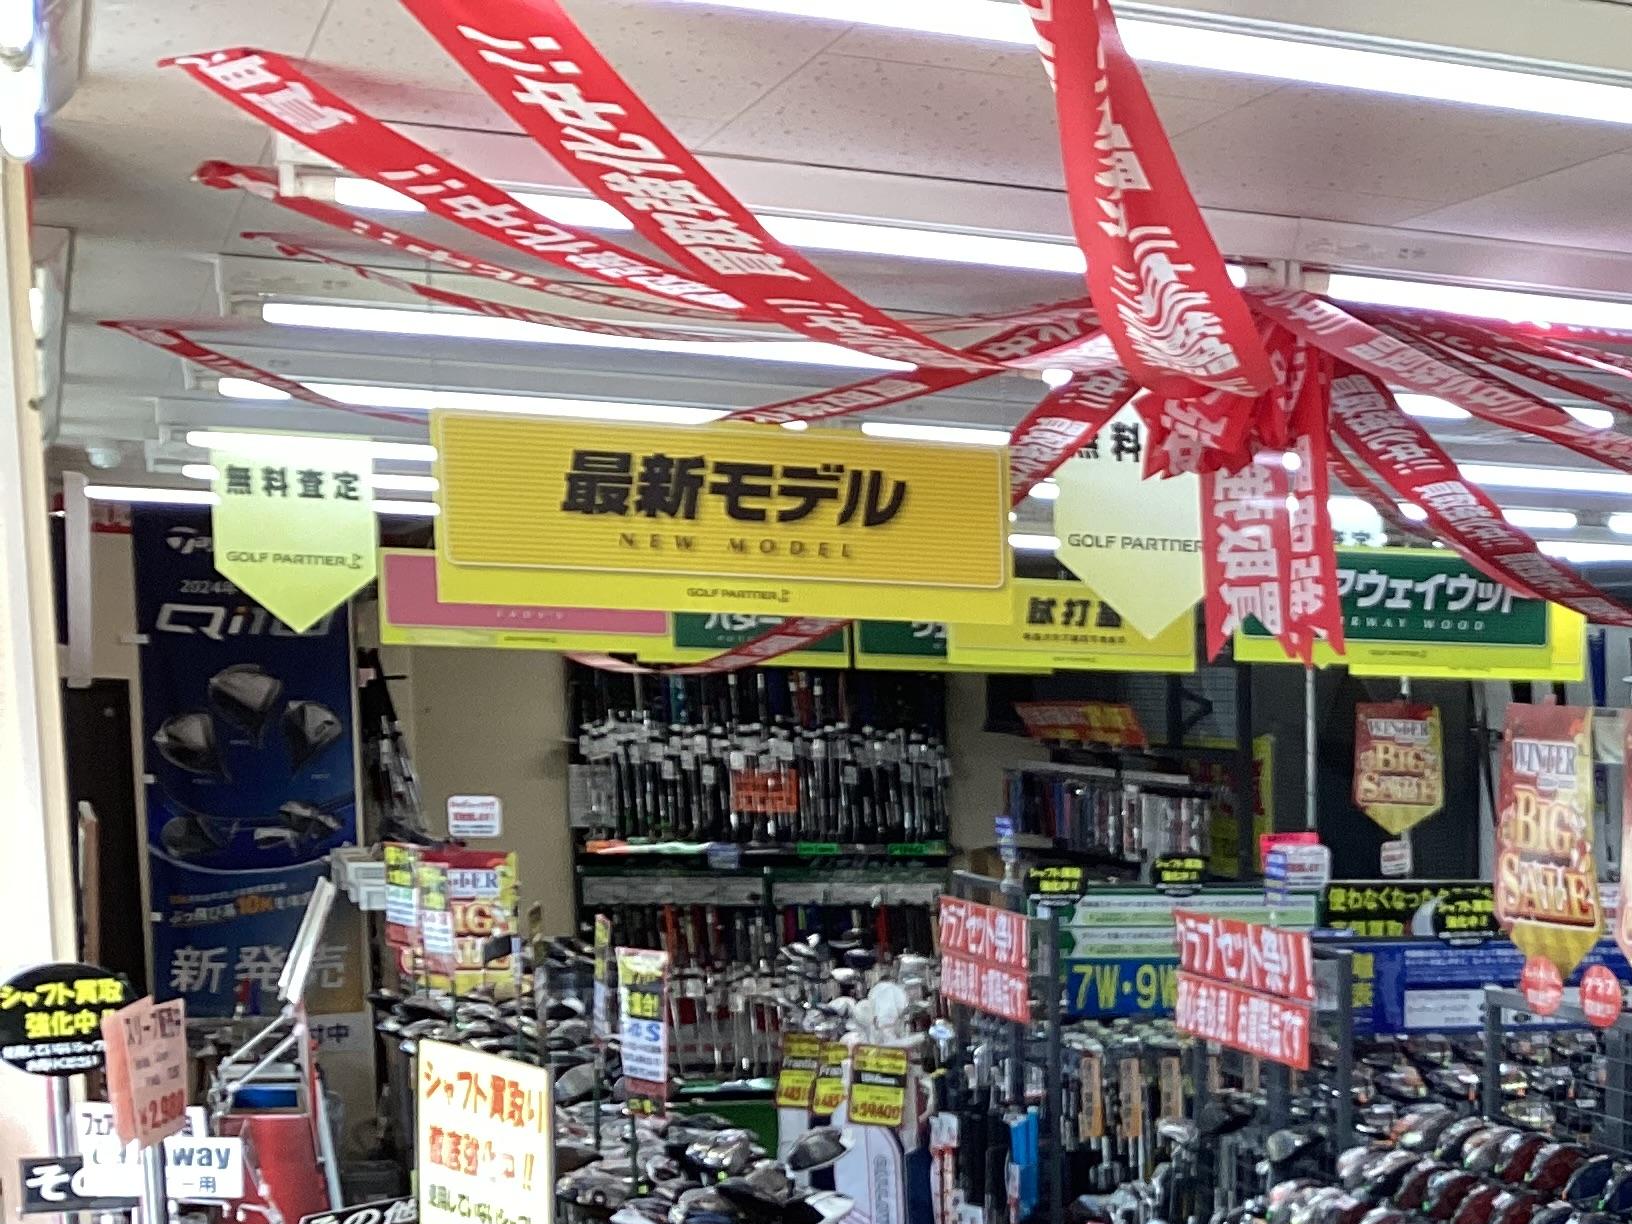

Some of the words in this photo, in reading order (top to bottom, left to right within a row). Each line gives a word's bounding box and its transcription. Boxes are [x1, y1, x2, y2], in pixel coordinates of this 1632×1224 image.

[225, 464, 361, 501] 無料査定
[561, 449, 908, 528] 最新モデル
[619, 532, 696, 551] NEW
[729, 536, 857, 558] MODEL
[1067, 533, 1116, 549] GOLF
[226, 551, 270, 564] GOLF
[272, 553, 347, 567] PARTNER
[1424, 618, 1484, 631] WOOD
[1368, 718, 1430, 738] WINTER
[1375, 744, 1427, 772] BIG
[1512, 740, 1577, 779] WINTER
[1358, 772, 1436, 801] SALE
[1512, 784, 1573, 857] BIG
[1499, 850, 1596, 926] SALE
[0, 977, 124, 1010] シャフト買取
[423, 1061, 544, 1134] シャフト買取り
[25, 1164, 86, 1202] そ
